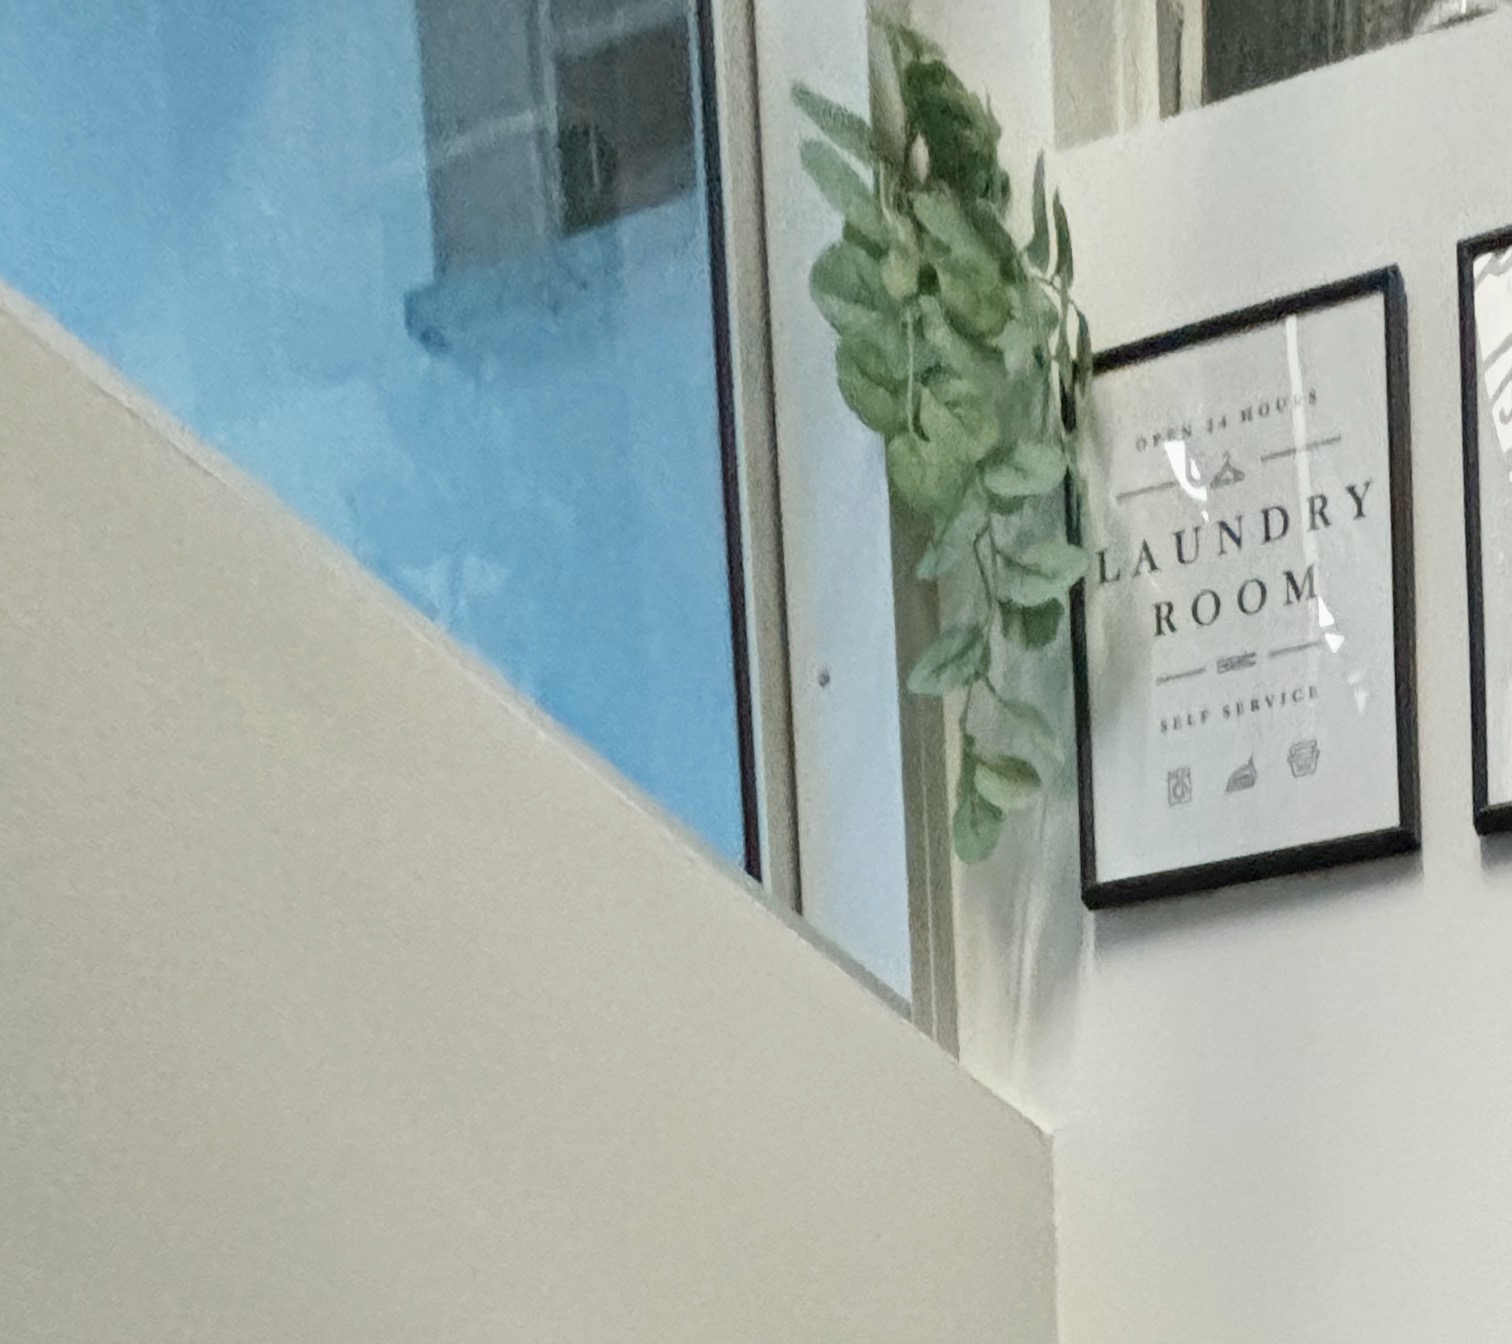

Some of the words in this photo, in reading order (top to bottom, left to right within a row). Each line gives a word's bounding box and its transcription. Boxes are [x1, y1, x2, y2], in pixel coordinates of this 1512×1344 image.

[1094, 478, 1373, 586] LAUNDRY
[1152, 563, 1319, 637] ROOM
[1160, 708, 1209, 734] SELF
[1222, 684, 1317, 720] SERVICE
